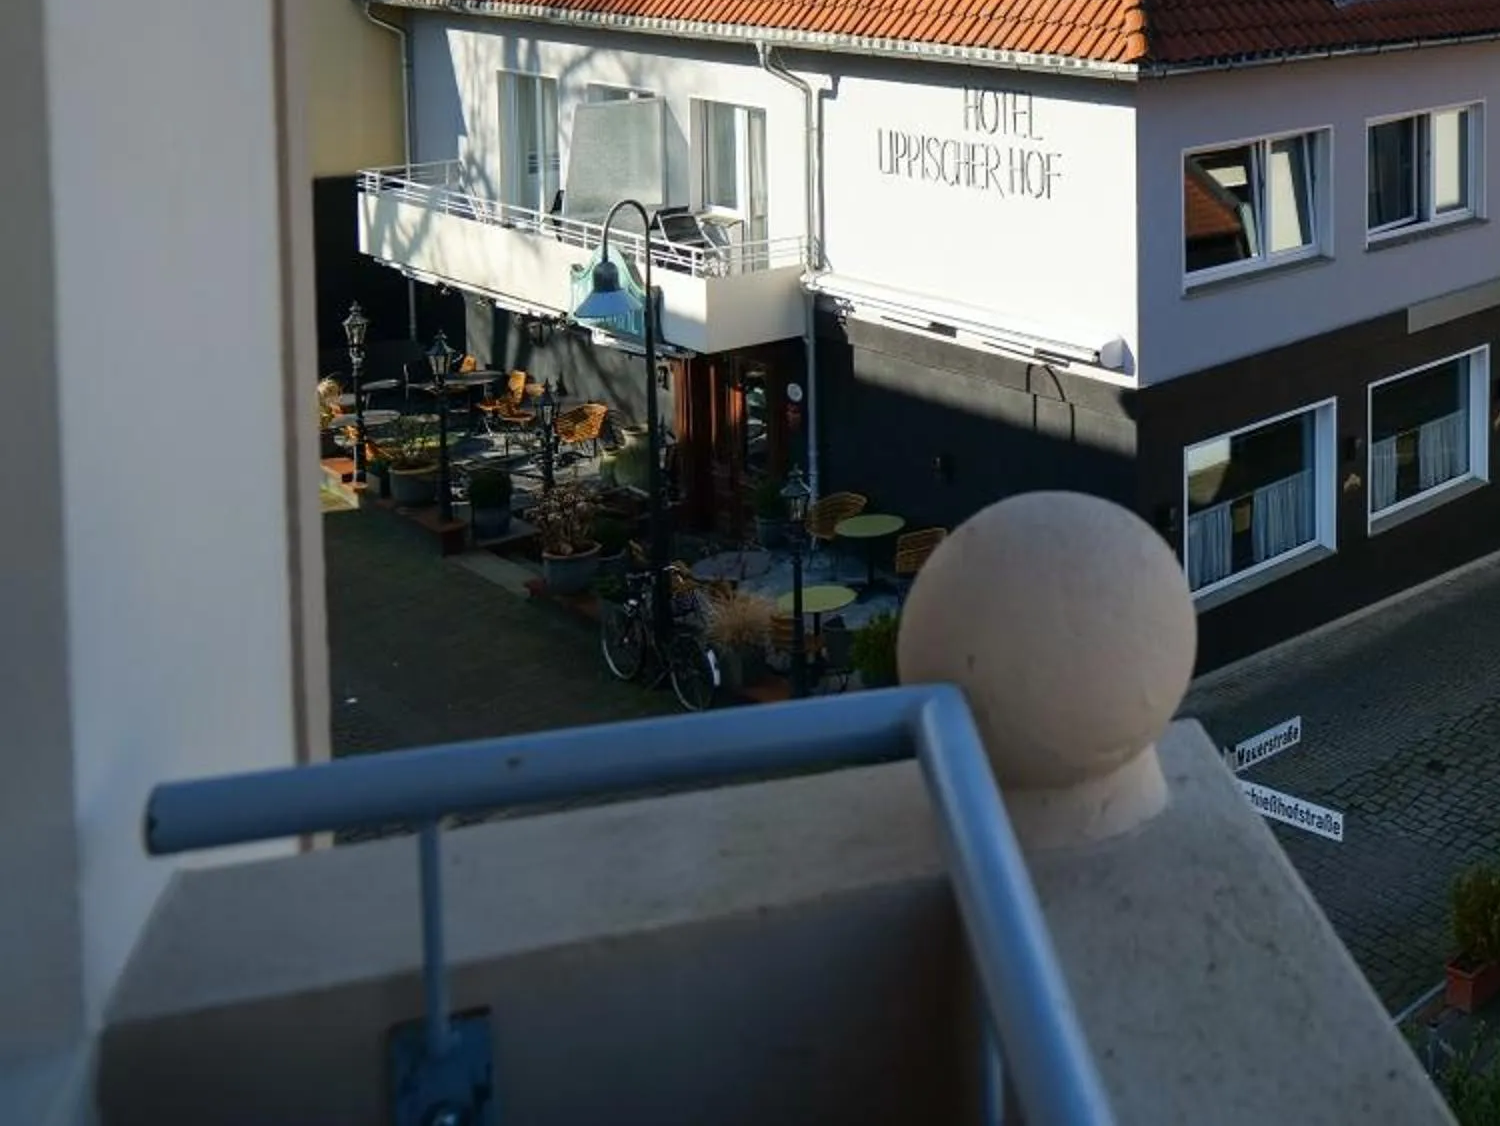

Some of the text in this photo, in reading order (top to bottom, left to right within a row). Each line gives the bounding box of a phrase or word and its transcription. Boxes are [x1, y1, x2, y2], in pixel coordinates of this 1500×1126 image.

[963, 85, 1043, 141] HOTEL
[878, 128, 1062, 200] LIPPISCHER HOF
[1245, 787, 1341, 835] hießhofstraße
